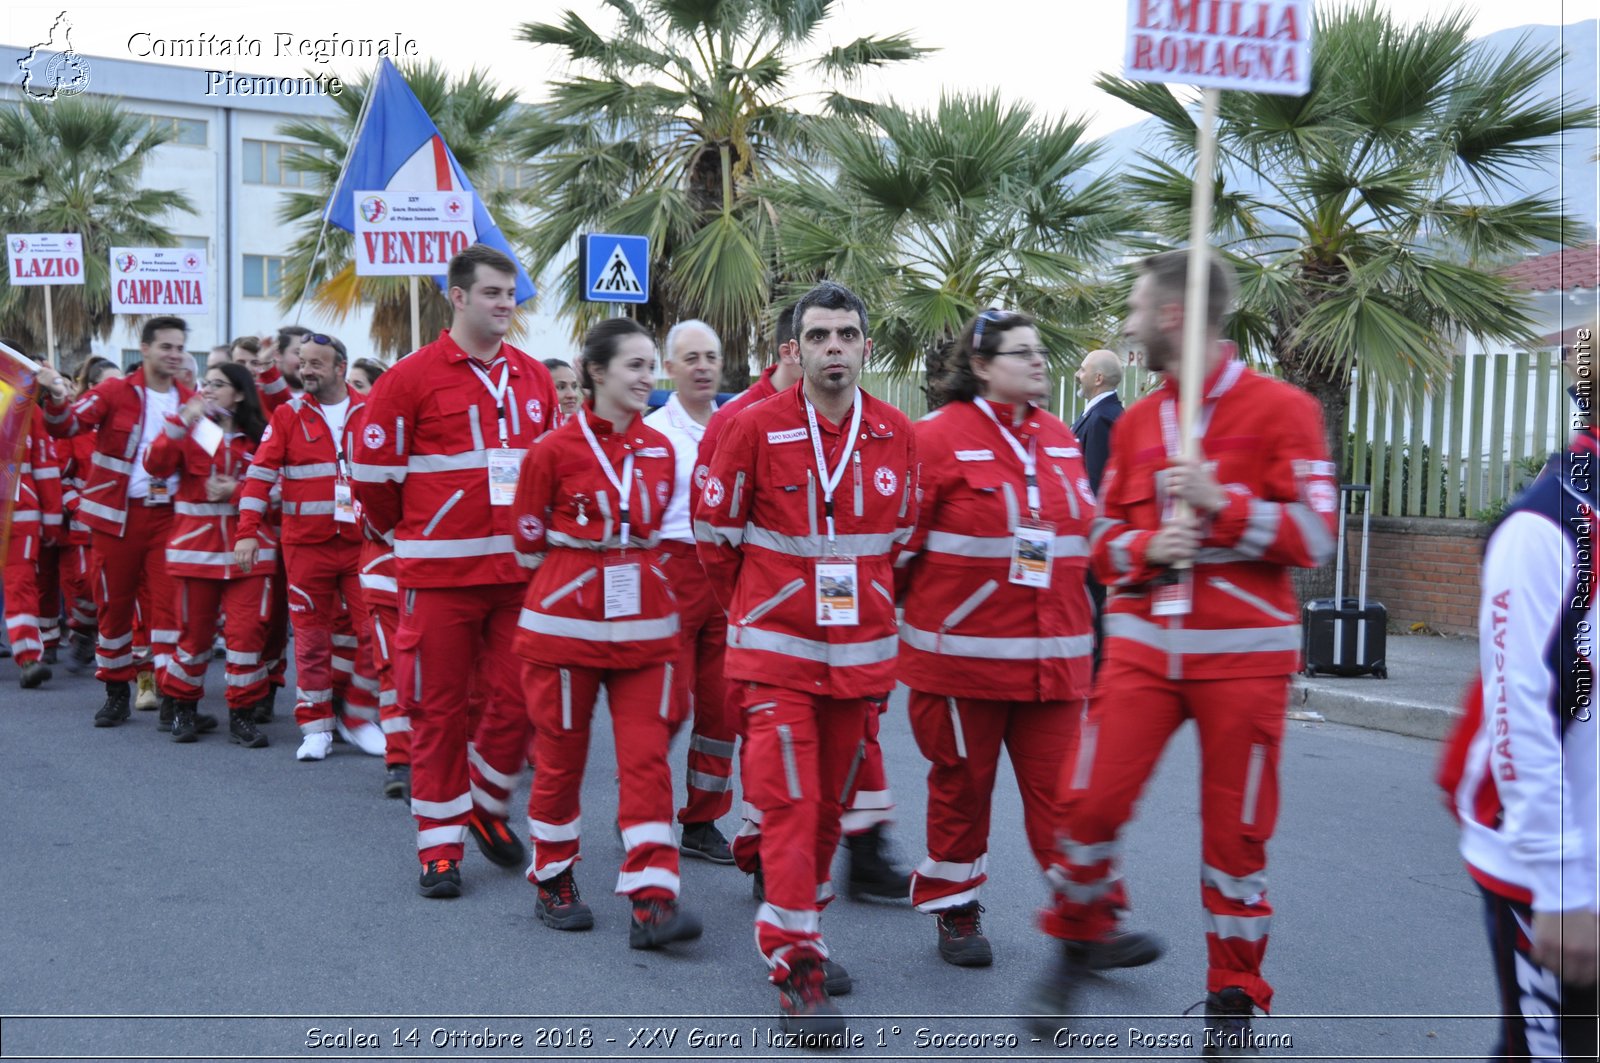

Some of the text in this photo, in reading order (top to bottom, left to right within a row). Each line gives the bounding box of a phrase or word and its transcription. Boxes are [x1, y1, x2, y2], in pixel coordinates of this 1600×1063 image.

[1134, 0, 1298, 40] EMILIA
[1131, 34, 1298, 82] ROMAGNA
[362, 231, 469, 265] VENETO
[15, 257, 80, 278] LAZIO
[117, 279, 203, 305] CAMPANIA
[1492, 589, 1518, 782] BASILICATA
